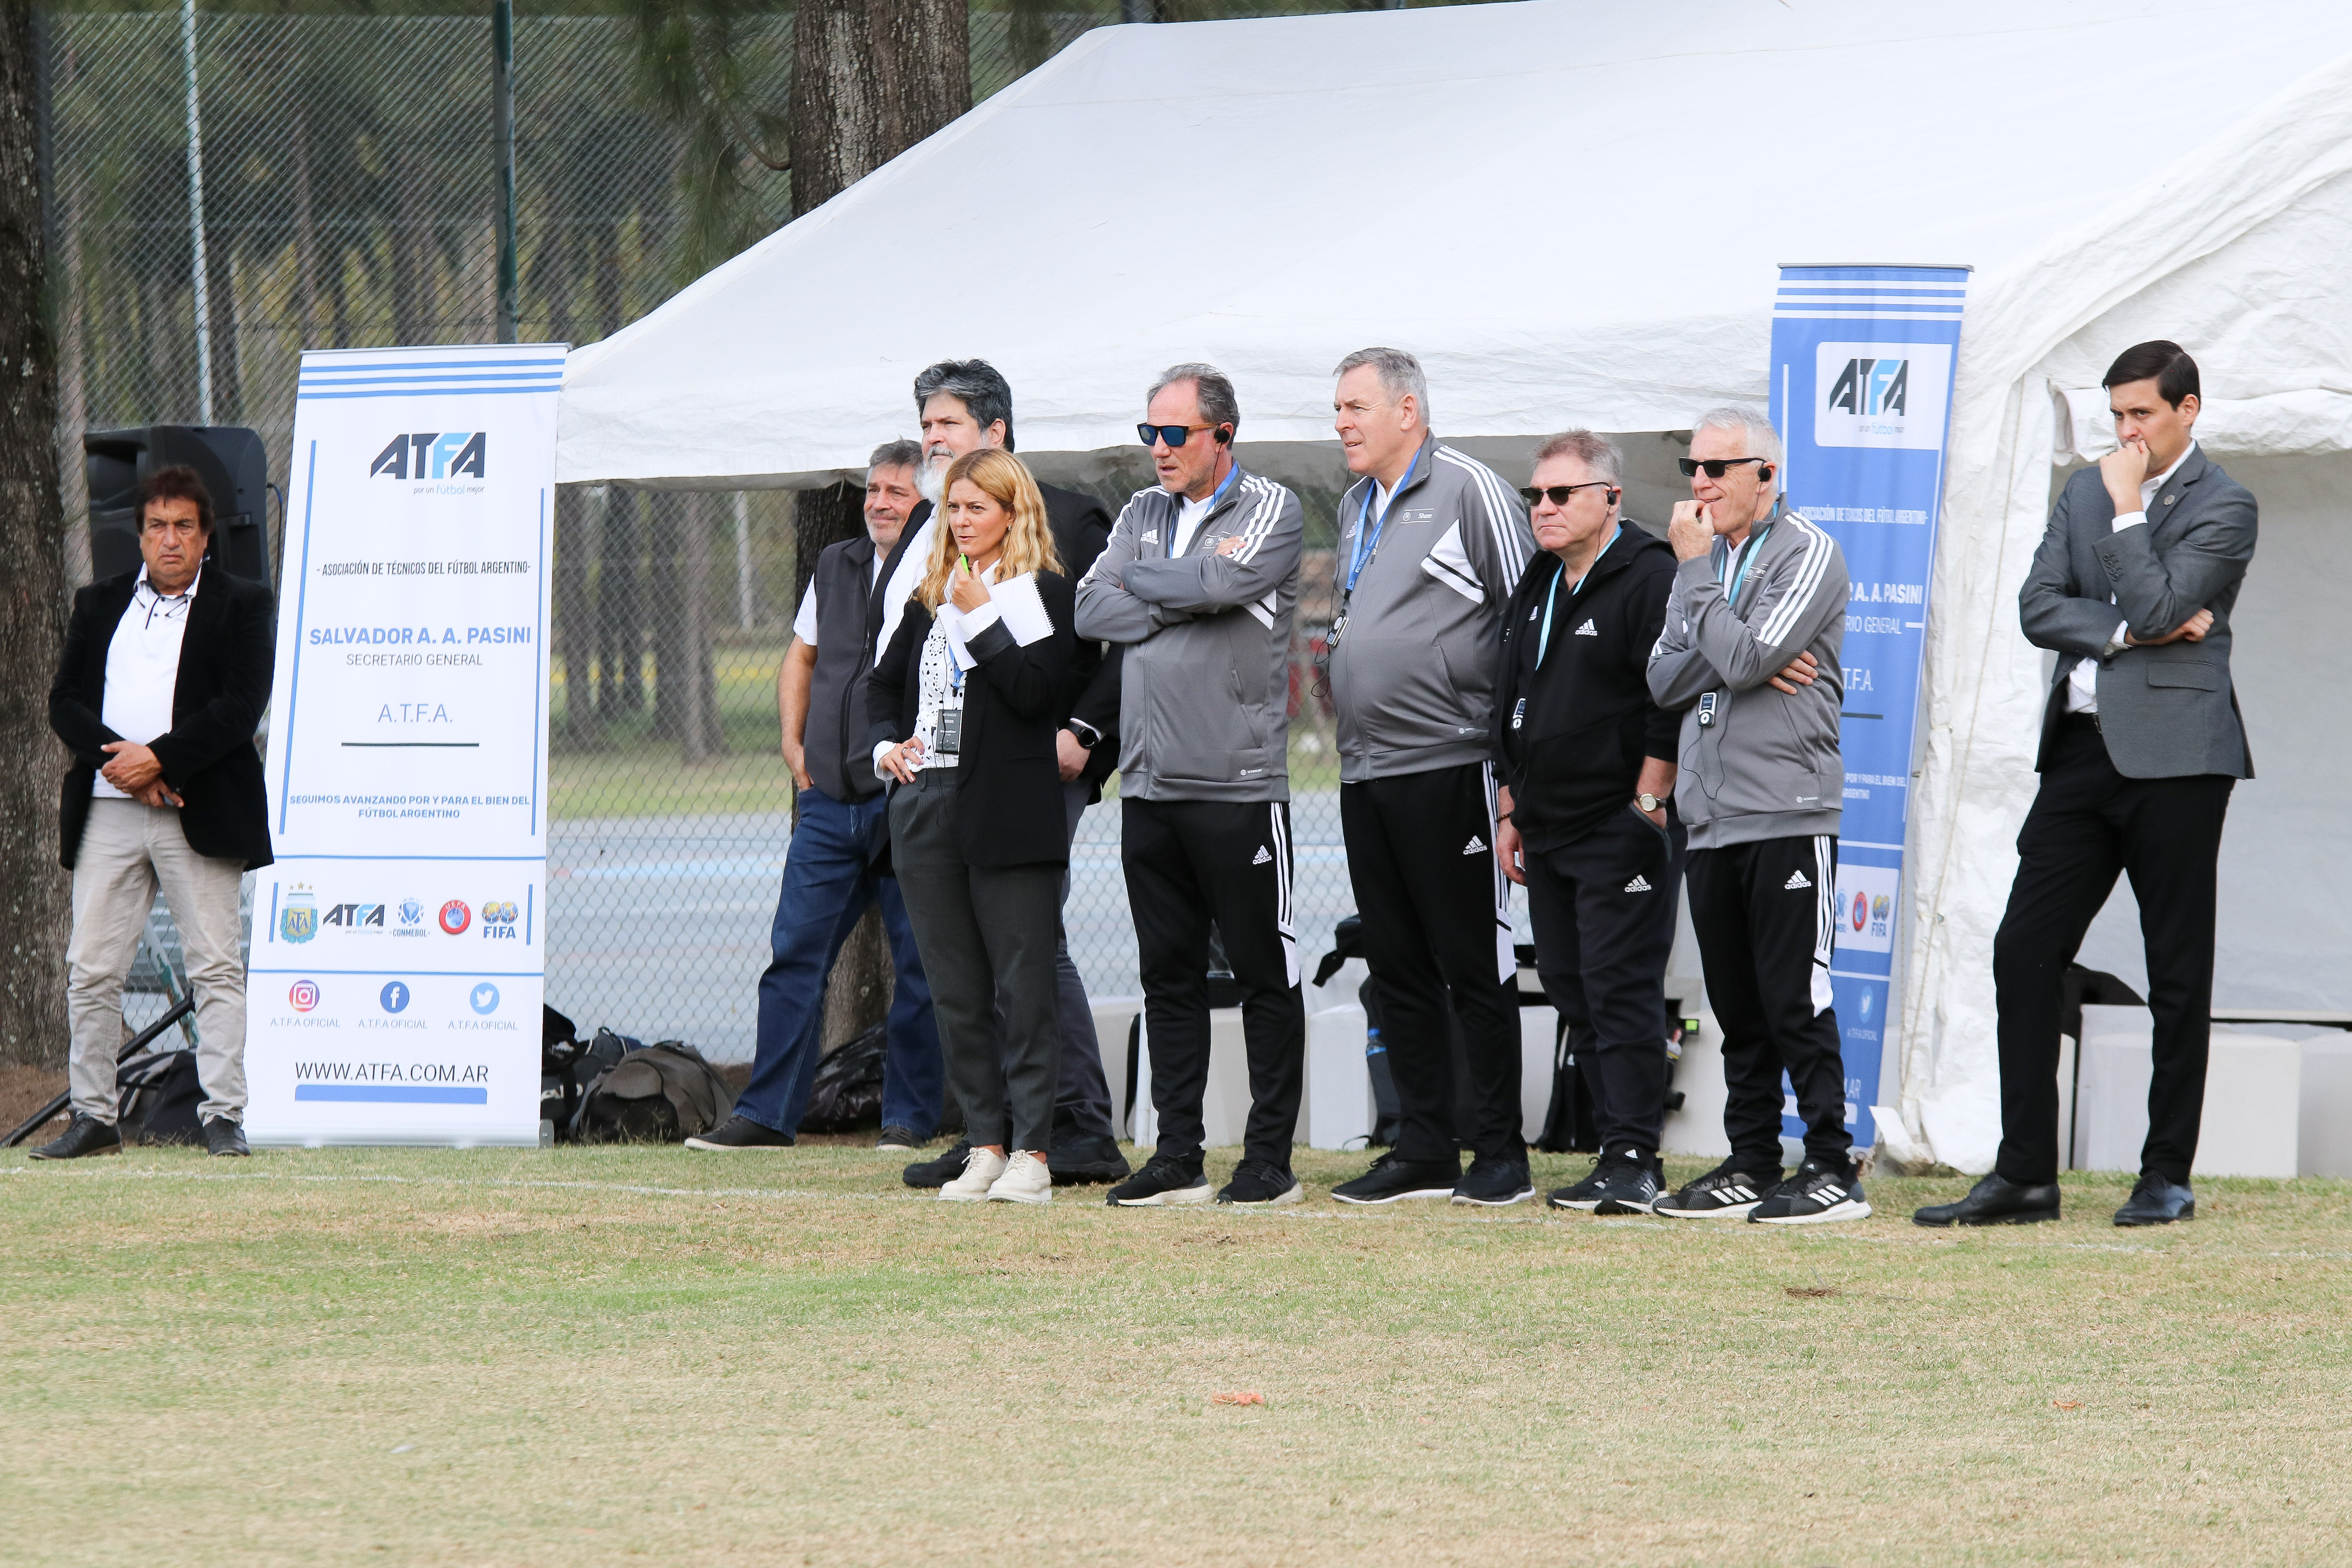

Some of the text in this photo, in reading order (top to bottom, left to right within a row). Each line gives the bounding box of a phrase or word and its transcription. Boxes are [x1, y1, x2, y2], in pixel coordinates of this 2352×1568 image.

[1829, 358, 1909, 416] ATFA
[370, 431, 486, 479] ATFA
[413, 487, 425, 496] por
[466, 485, 485, 495] mejor
[322, 560, 369, 576] ASOCIACIÓN
[372, 562, 384, 575] DE
[386, 559, 426, 575] TÉCNICOS
[428, 562, 445, 575] DEL
[447, 559, 479, 575] FÚTBOL
[1883, 583, 1923, 604] PASINI
[1864, 616, 1902, 635] GENERAL
[309, 626, 531, 645] SALVADOR A. A. PASINI
[346, 653, 483, 666] SECRETARIO GENERAL
[1841, 667, 1874, 691] T.F.A.
[377, 703, 453, 723] A.T.F.A.
[290, 795, 530, 806] SEGUIMOS AVANZANDO POR Y PARA EL BIEN DEL
[358, 807, 460, 819] FÚTBOL ARGENTINO
[1463, 845, 1488, 855] adidas
[1252, 855, 1272, 865] adidas
[1624, 884, 1651, 893] adidas
[1784, 880, 1811, 889] adidas
[445, 901, 466, 910] UEFA
[323, 903, 385, 927] ATFA
[483, 926, 516, 939] FIFA
[270, 1017, 341, 1028] A.T.F.A OFICIAL
[358, 1018, 428, 1029] A.T.F.A OFICIAL
[448, 1020, 518, 1031] A.T.F.A OFICIAL
[295, 1062, 488, 1083] WWW.ATFA.COM.AR
